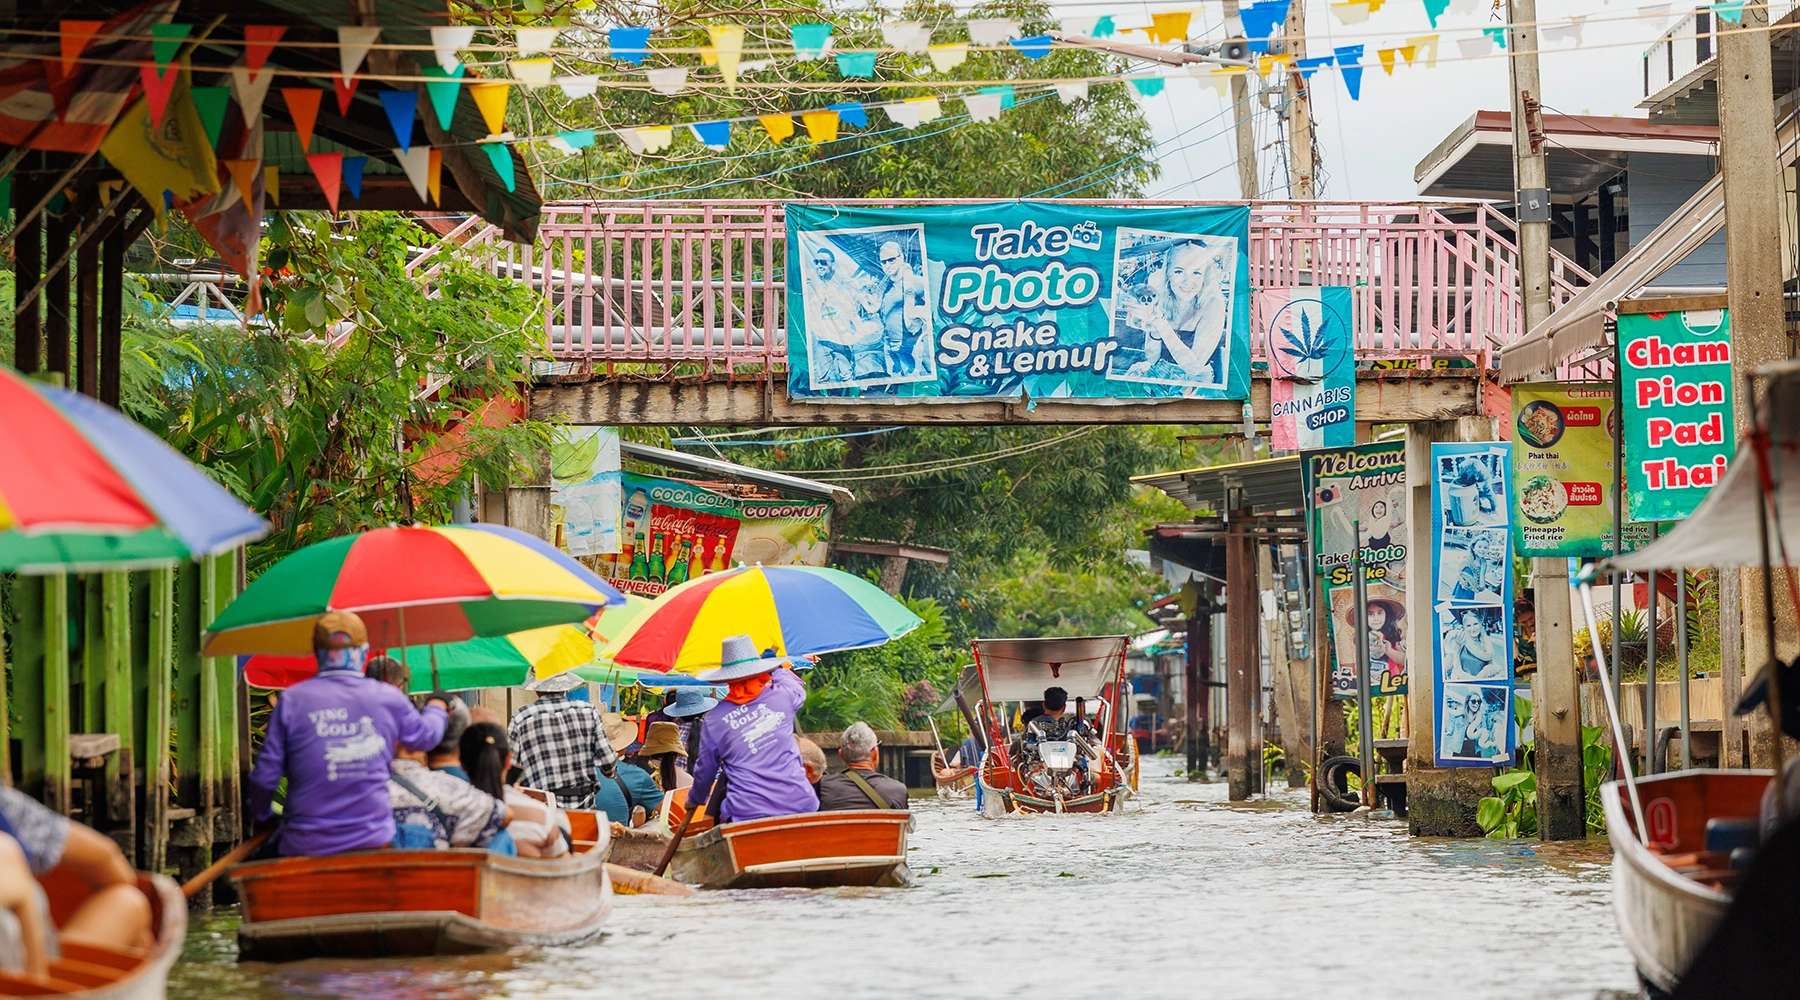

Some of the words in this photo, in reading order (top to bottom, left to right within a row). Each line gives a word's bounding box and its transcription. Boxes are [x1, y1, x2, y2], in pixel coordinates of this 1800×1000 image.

[972, 222, 1070, 259] Take
[945, 264, 1096, 311] Photo
[938, 320, 1057, 364] Snake
[1627, 337, 1729, 367] Cham
[1372, 359, 1449, 372] Snae
[1567, 387, 1616, 399] Cham
[1637, 376, 1724, 407] Pion
[1272, 387, 1351, 417] CANNABIS
[1312, 409, 1347, 428] SHOP
[1649, 413, 1723, 446] Pad
[1528, 452, 1544, 460] Phat
[1546, 452, 1559, 460] thai
[1643, 456, 1727, 488] Thai
[651, 487, 694, 505] COCA
[695, 493, 735, 508] COLA
[742, 504, 827, 519] COCONUT
[1523, 526, 1566, 534] Pineapple
[1317, 552, 1349, 566] Take
[1332, 567, 1386, 584] Snke
[608, 578, 667, 594] HEINEKEN
[722, 704, 748, 723] YING
